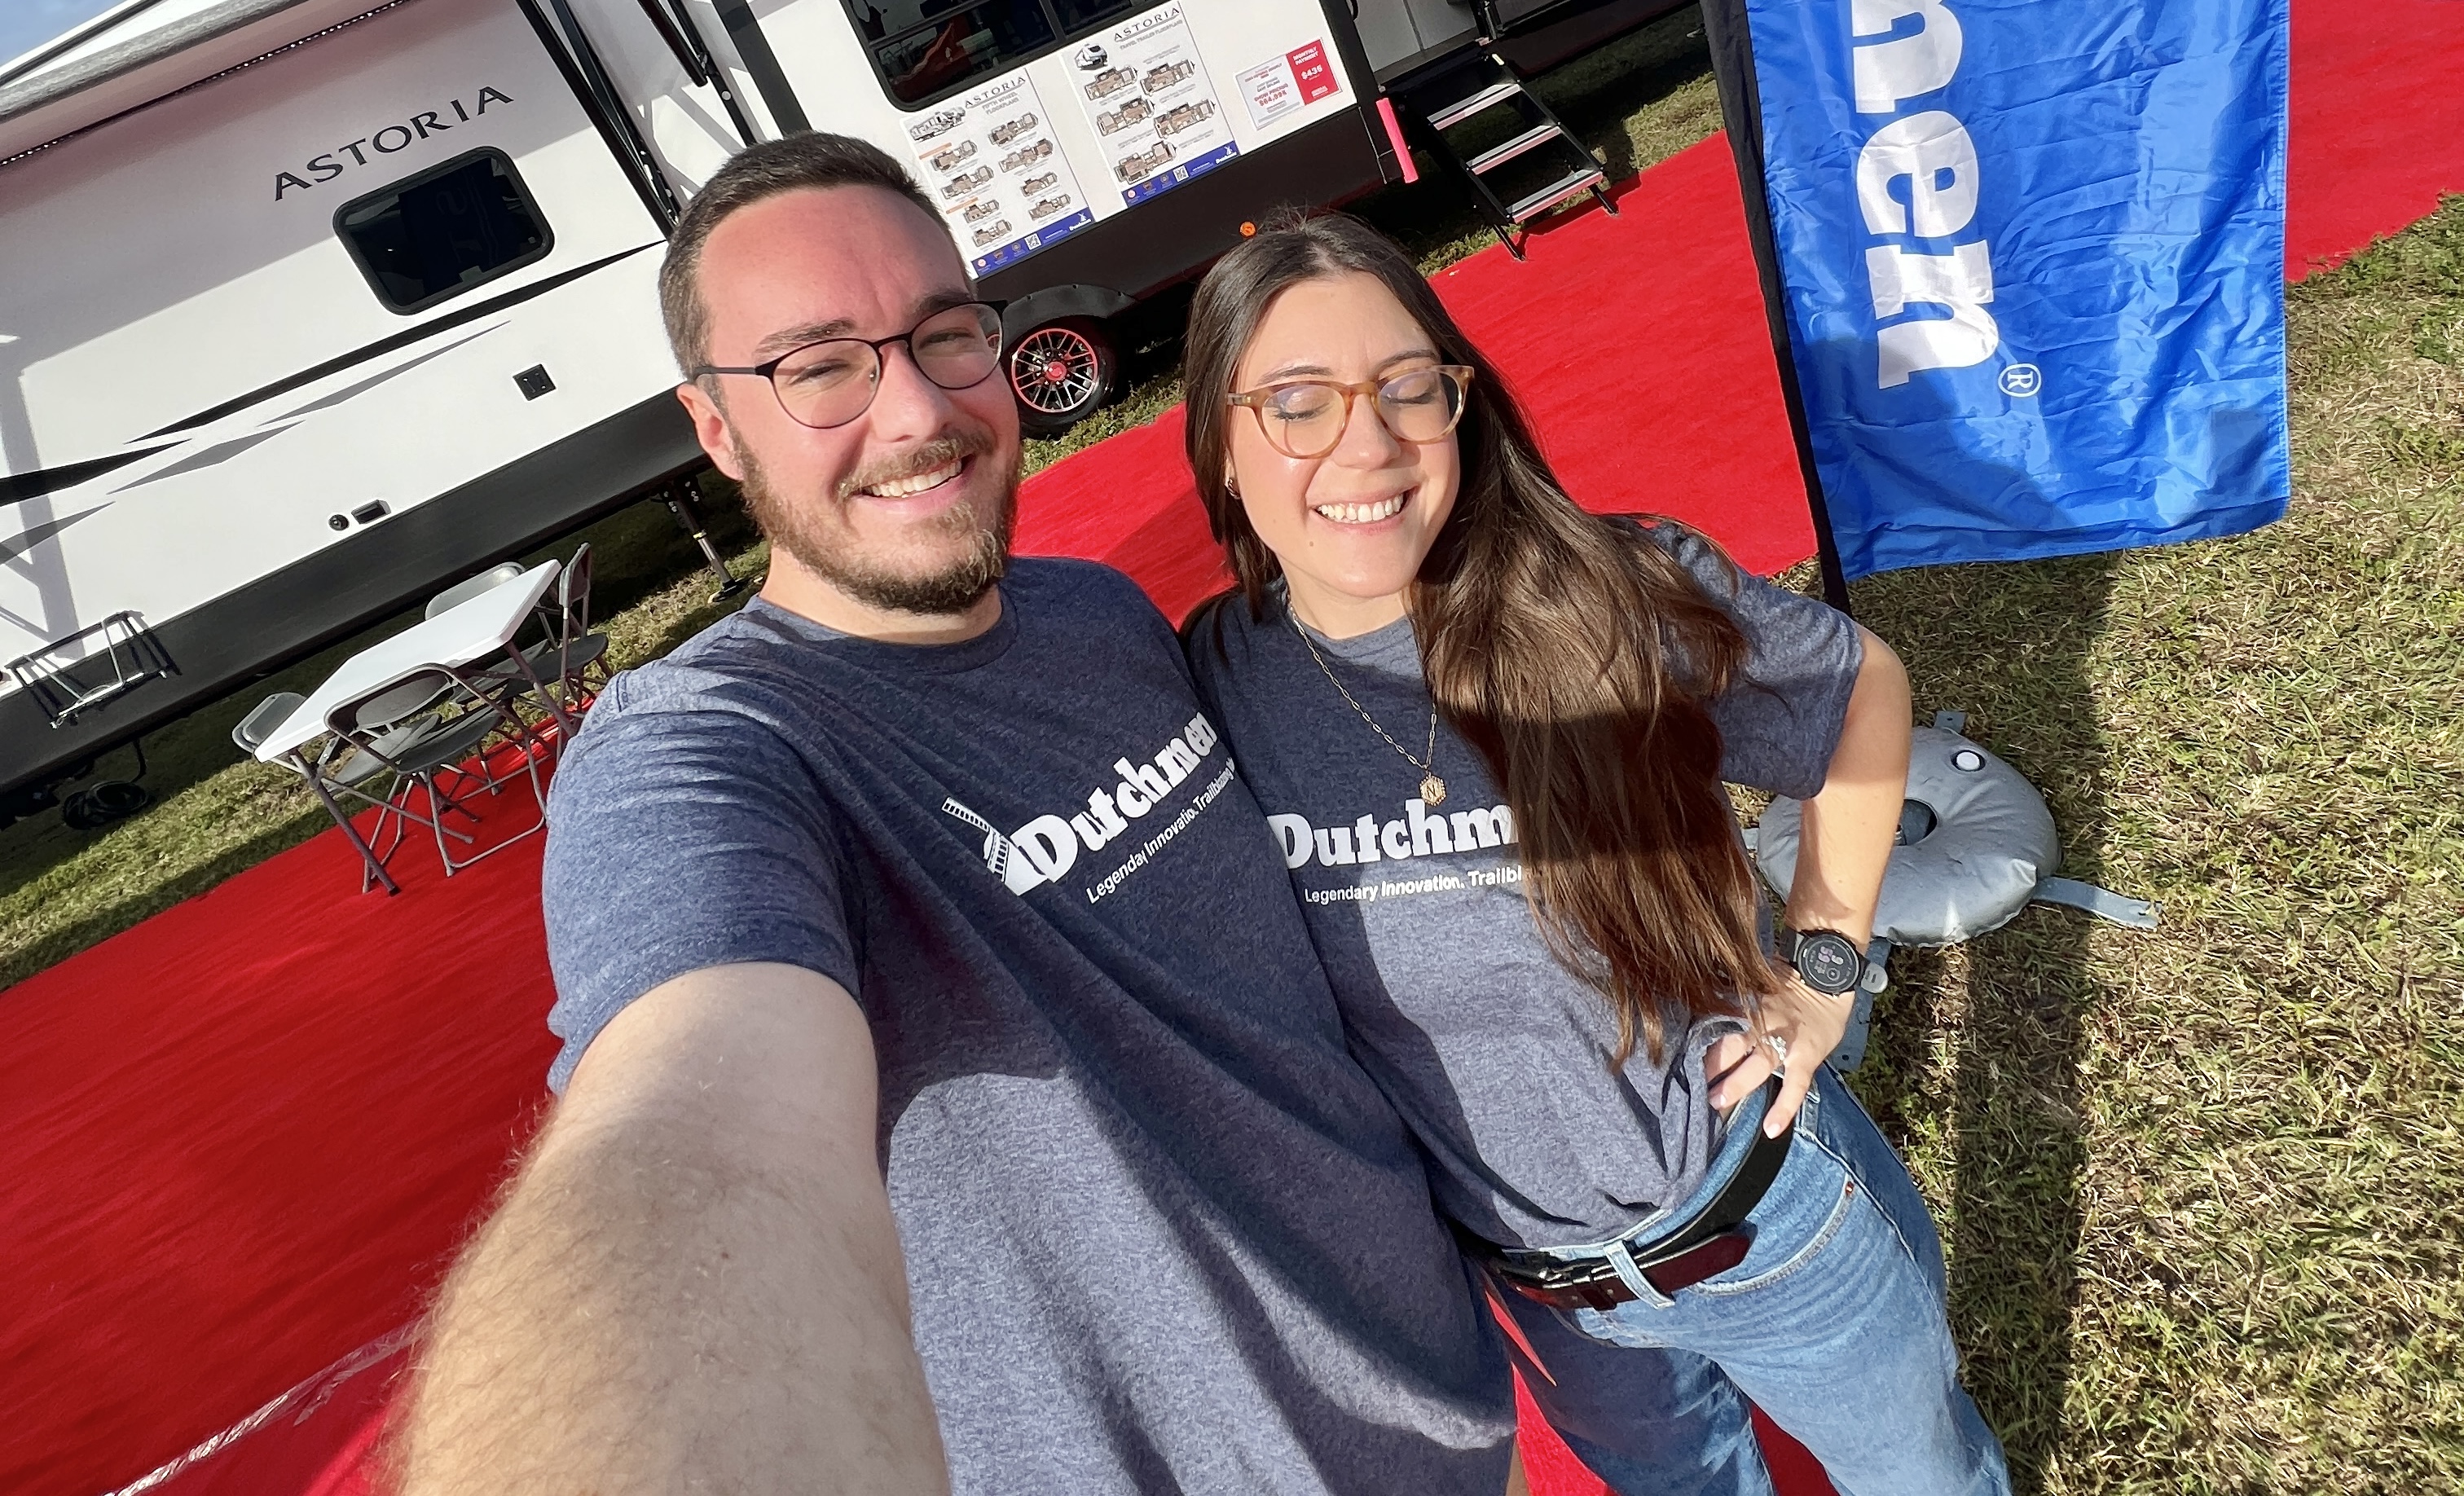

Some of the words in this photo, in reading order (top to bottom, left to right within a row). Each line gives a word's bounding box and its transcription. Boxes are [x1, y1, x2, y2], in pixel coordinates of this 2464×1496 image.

[1114, 7, 1180, 42] ASTORIA
[965, 77, 1026, 108] ASTORIA
[275, 86, 514, 202] ASTORIA
[1010, 711, 1218, 883] Dutchmen
[1266, 799, 1520, 869] Dutchm
[1305, 885, 1379, 905] Legendary
[1381, 873, 1465, 897] Innovation.
[1467, 865, 1522, 887] Trailbl
